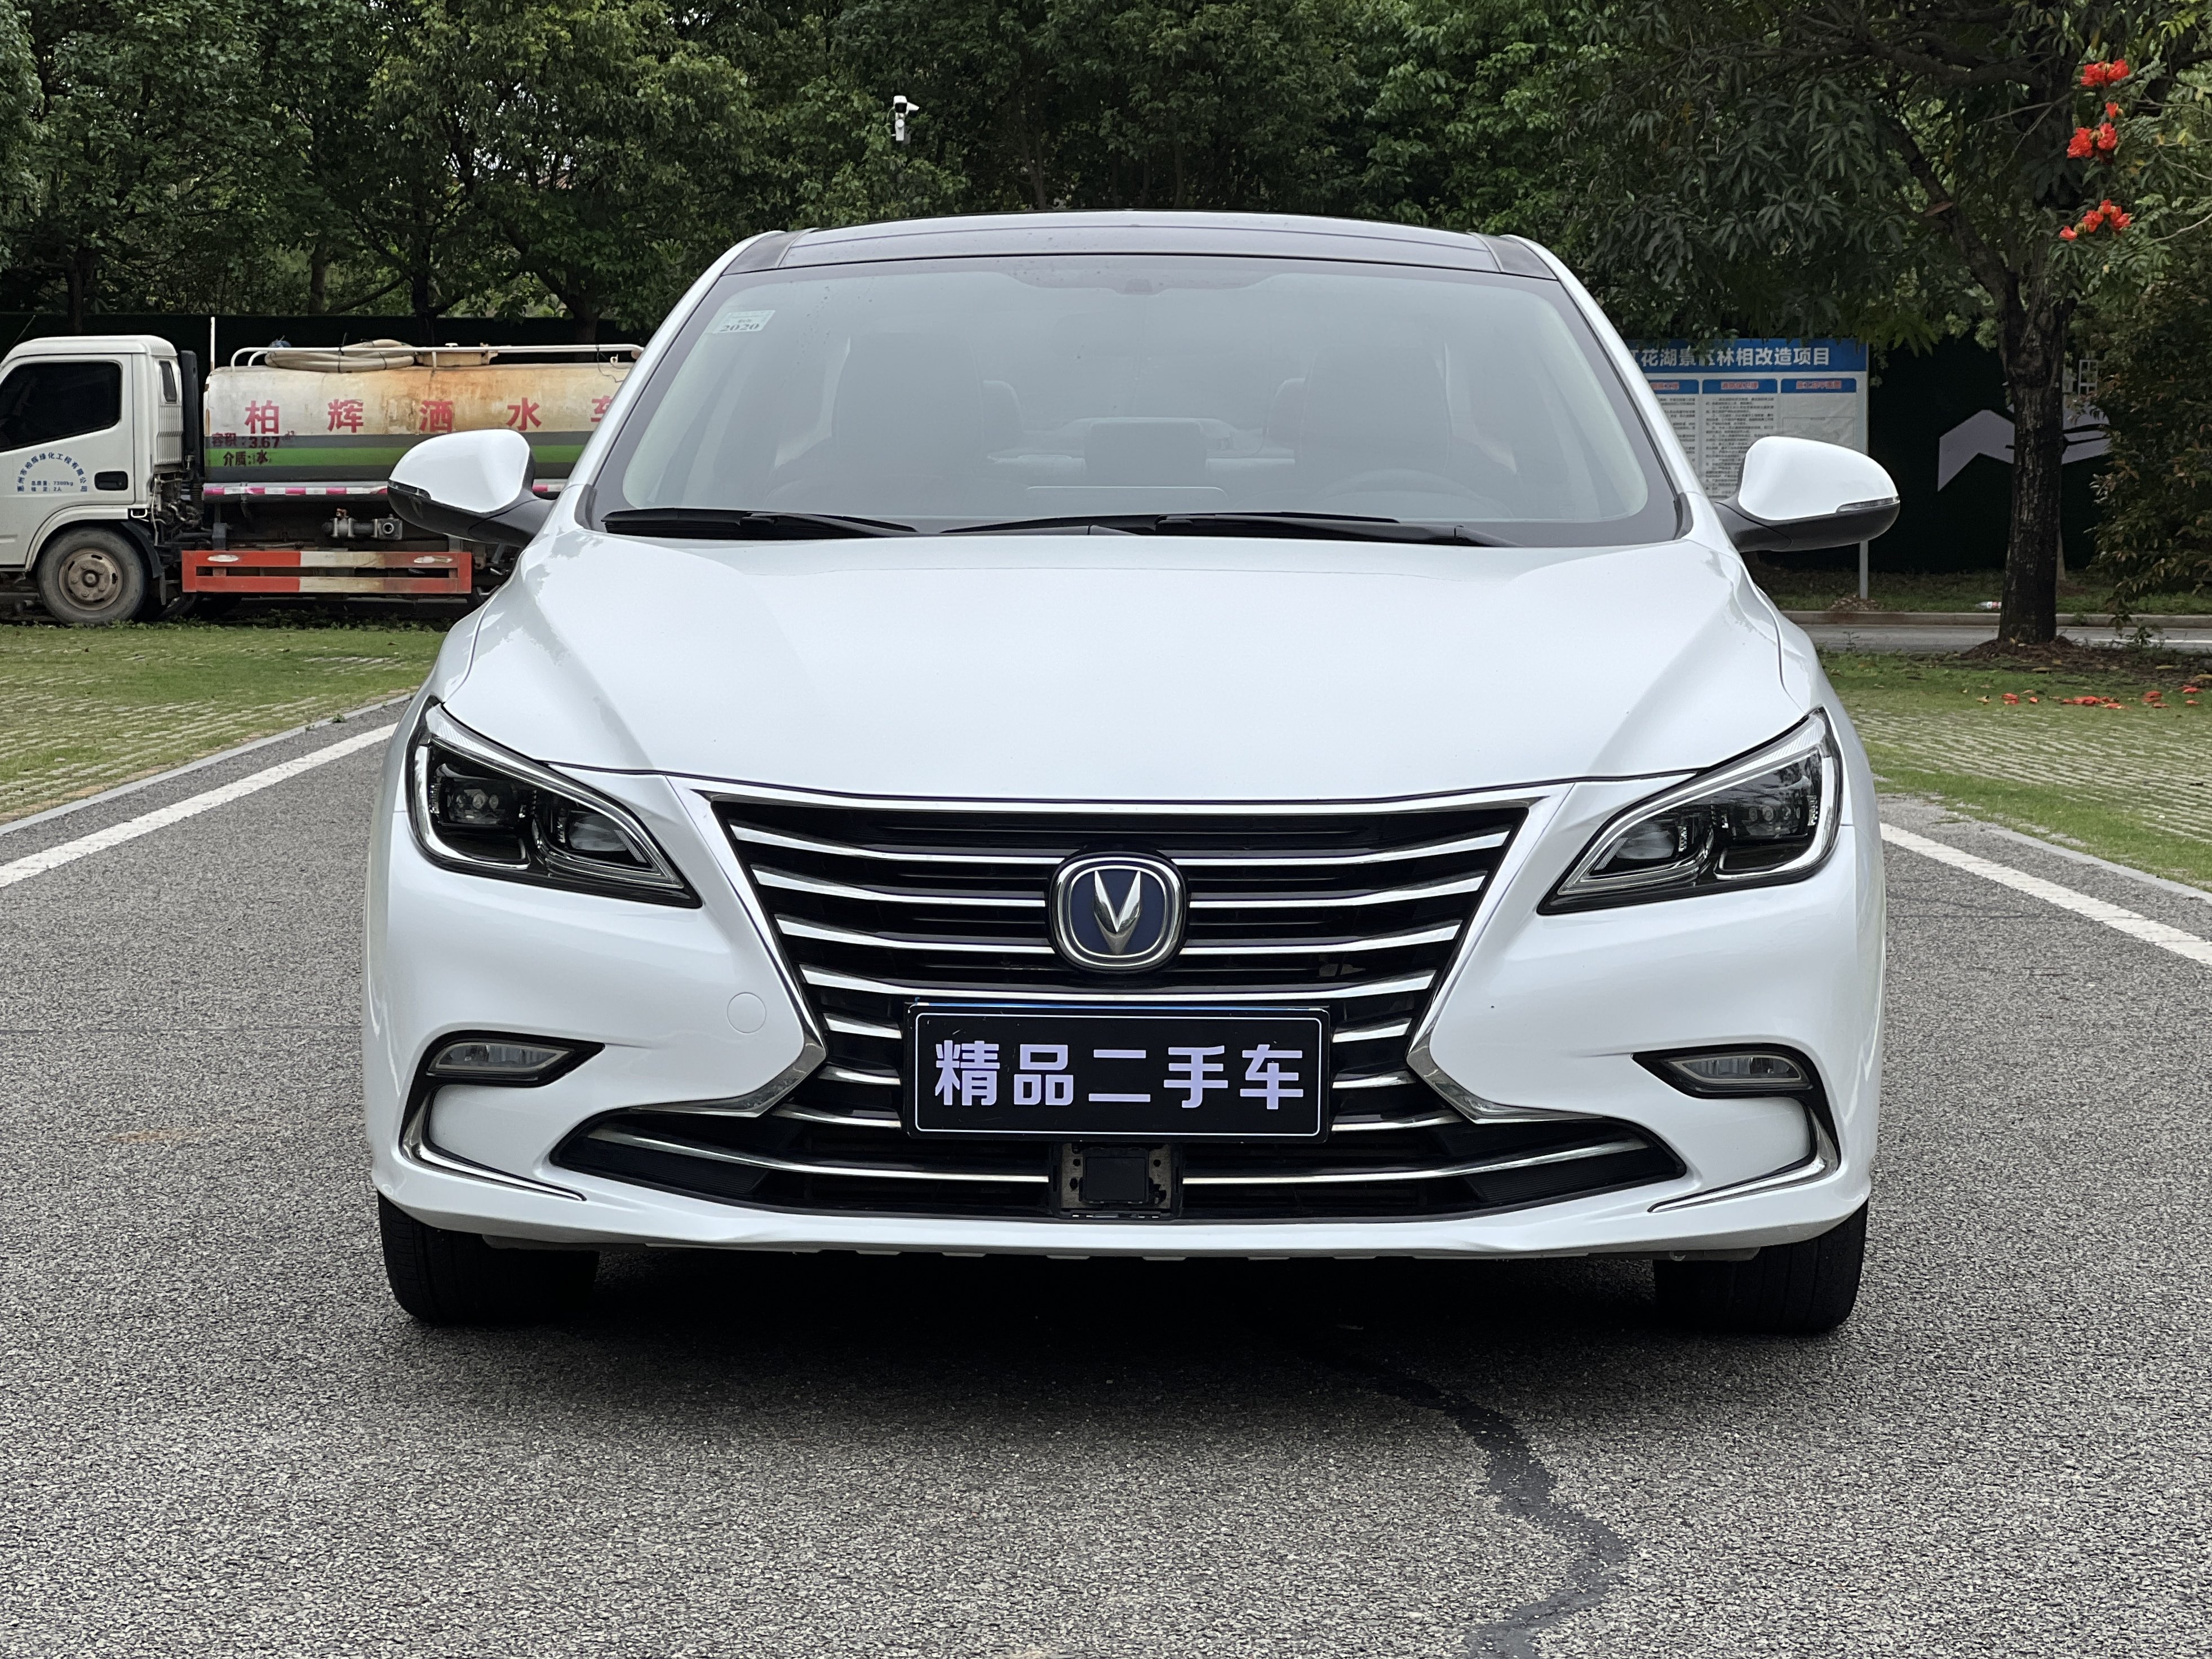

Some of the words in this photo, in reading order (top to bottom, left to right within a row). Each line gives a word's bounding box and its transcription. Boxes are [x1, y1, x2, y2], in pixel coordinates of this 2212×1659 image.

[719, 323, 760, 332] 2020
[1629, 348, 1829, 367] 花湖景林相改造项目
[934, 1039, 1304, 1110] 精品二手车
